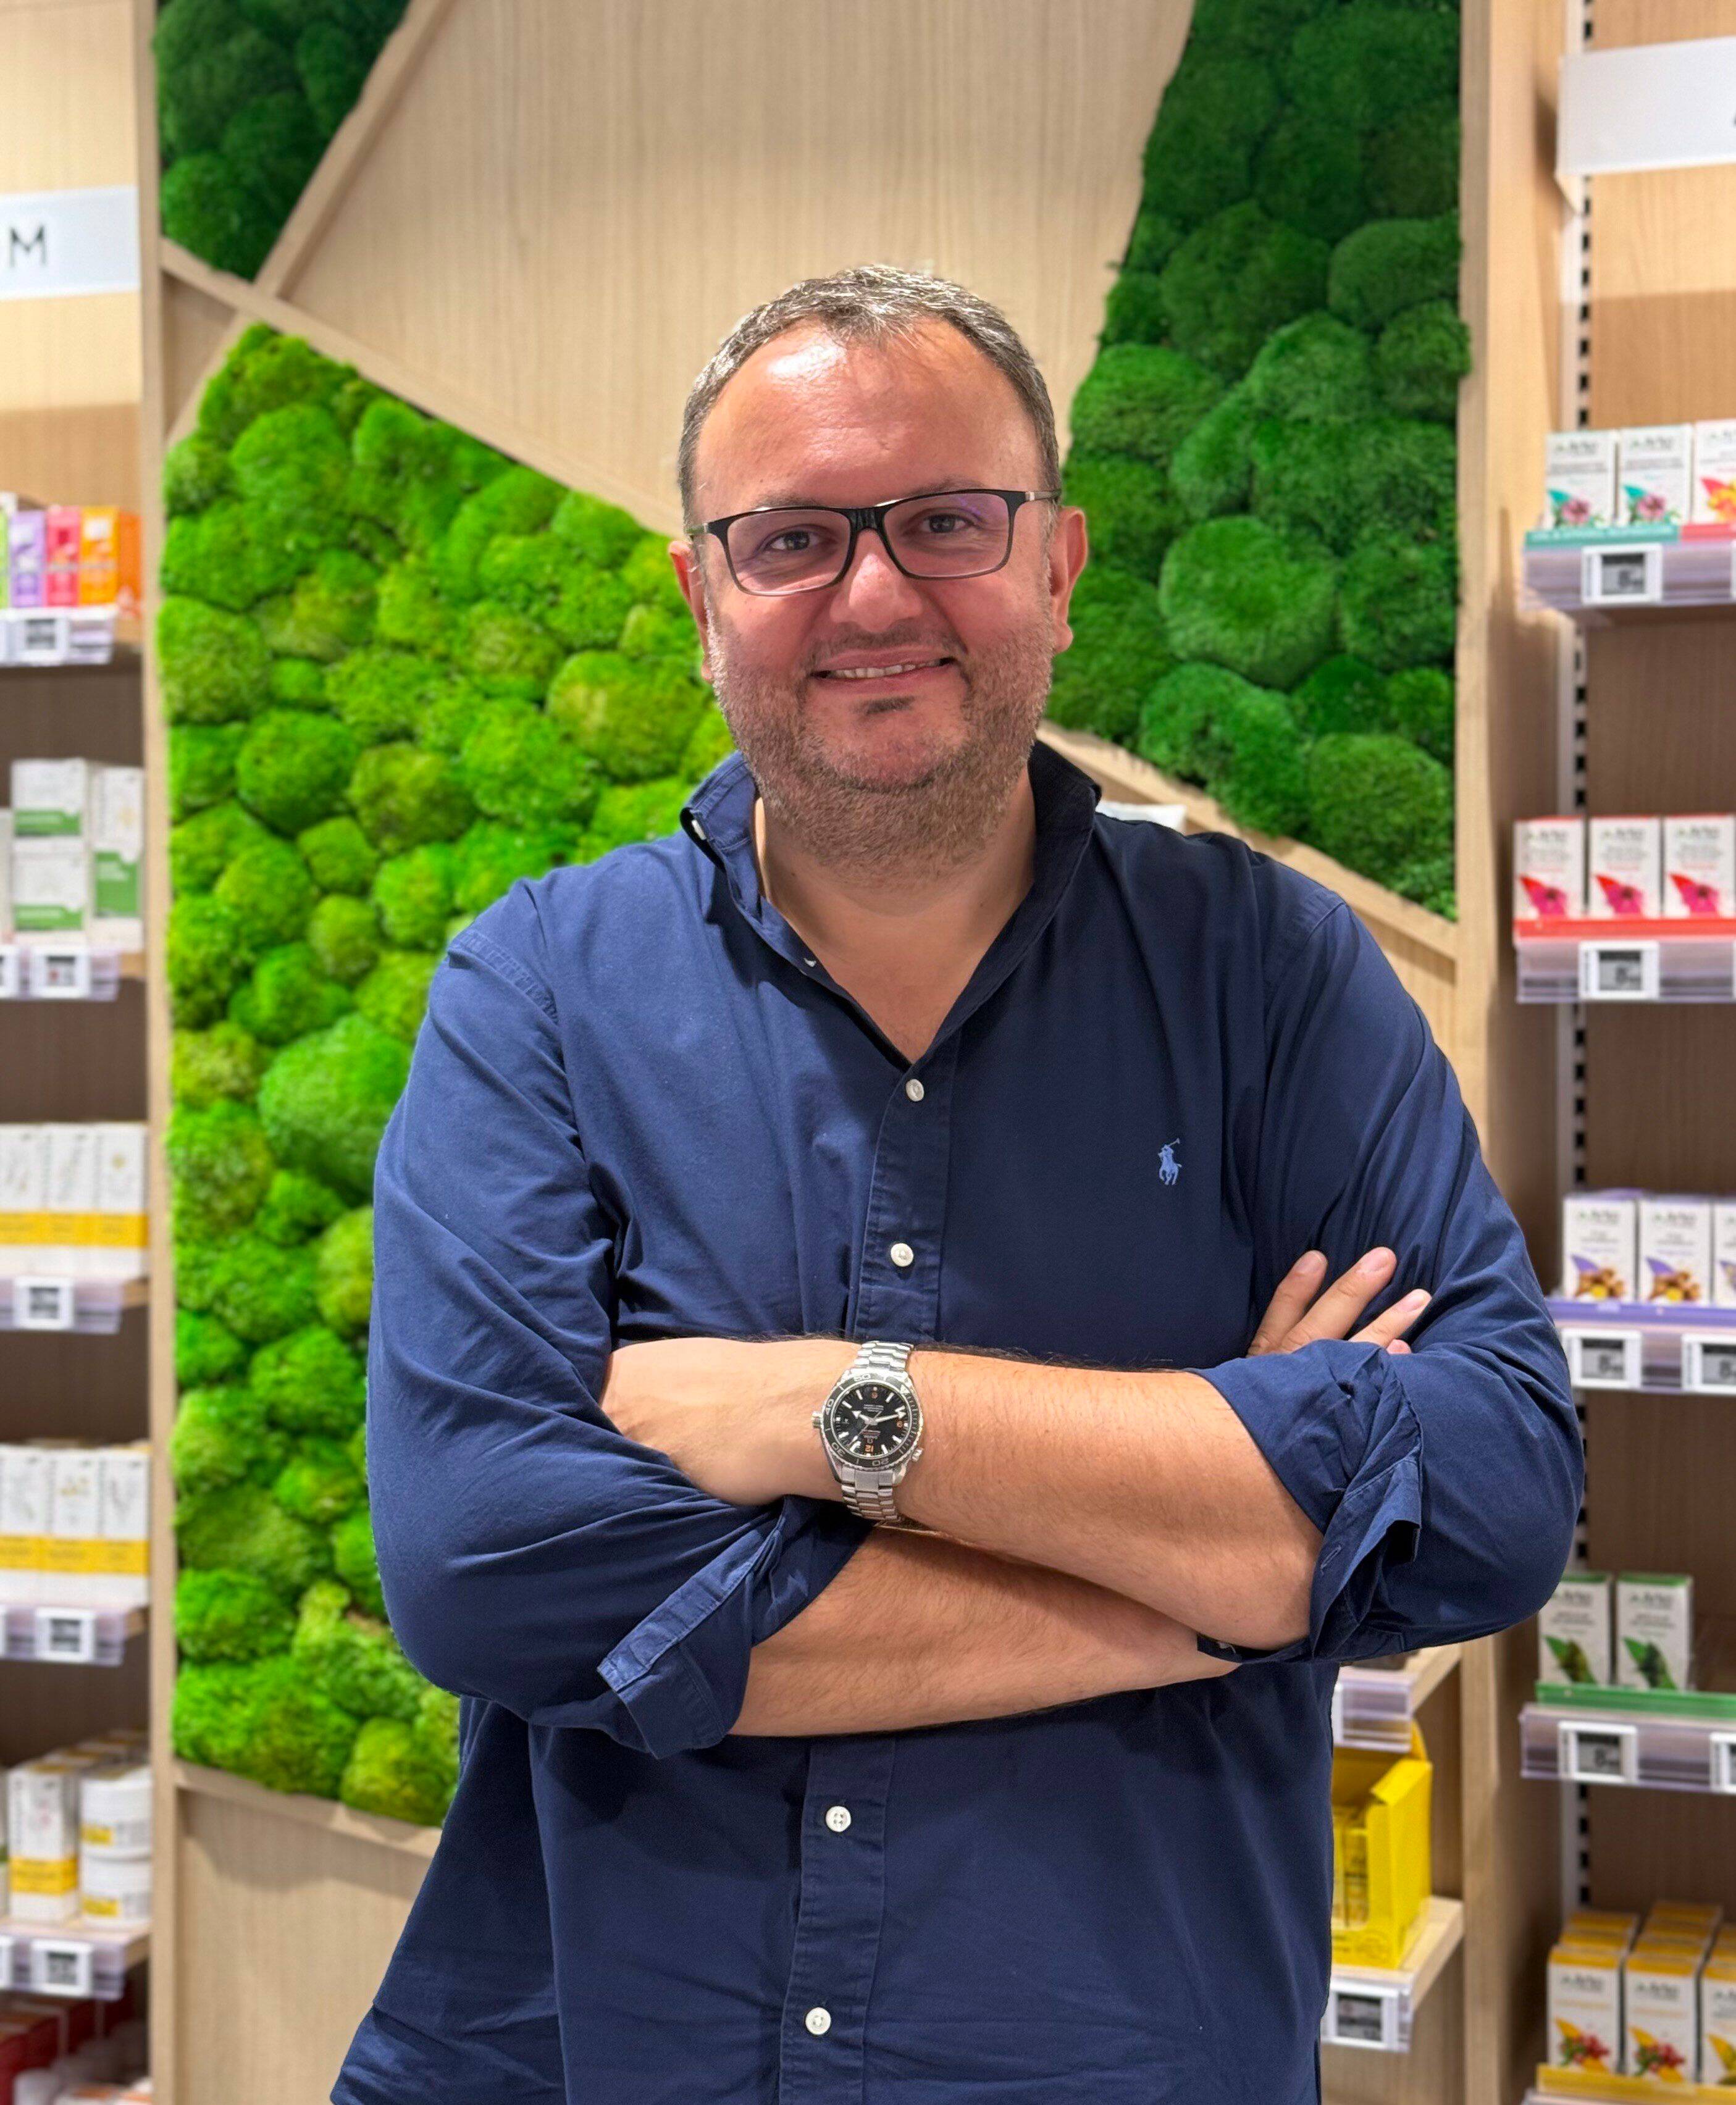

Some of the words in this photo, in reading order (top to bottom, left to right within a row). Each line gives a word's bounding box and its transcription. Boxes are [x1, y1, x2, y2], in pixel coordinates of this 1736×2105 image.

[10, 225, 46, 267] M
[826, 1399, 834, 1415] 40
[832, 1442, 845, 1456] 30
[872, 1458, 889, 1467] 20
